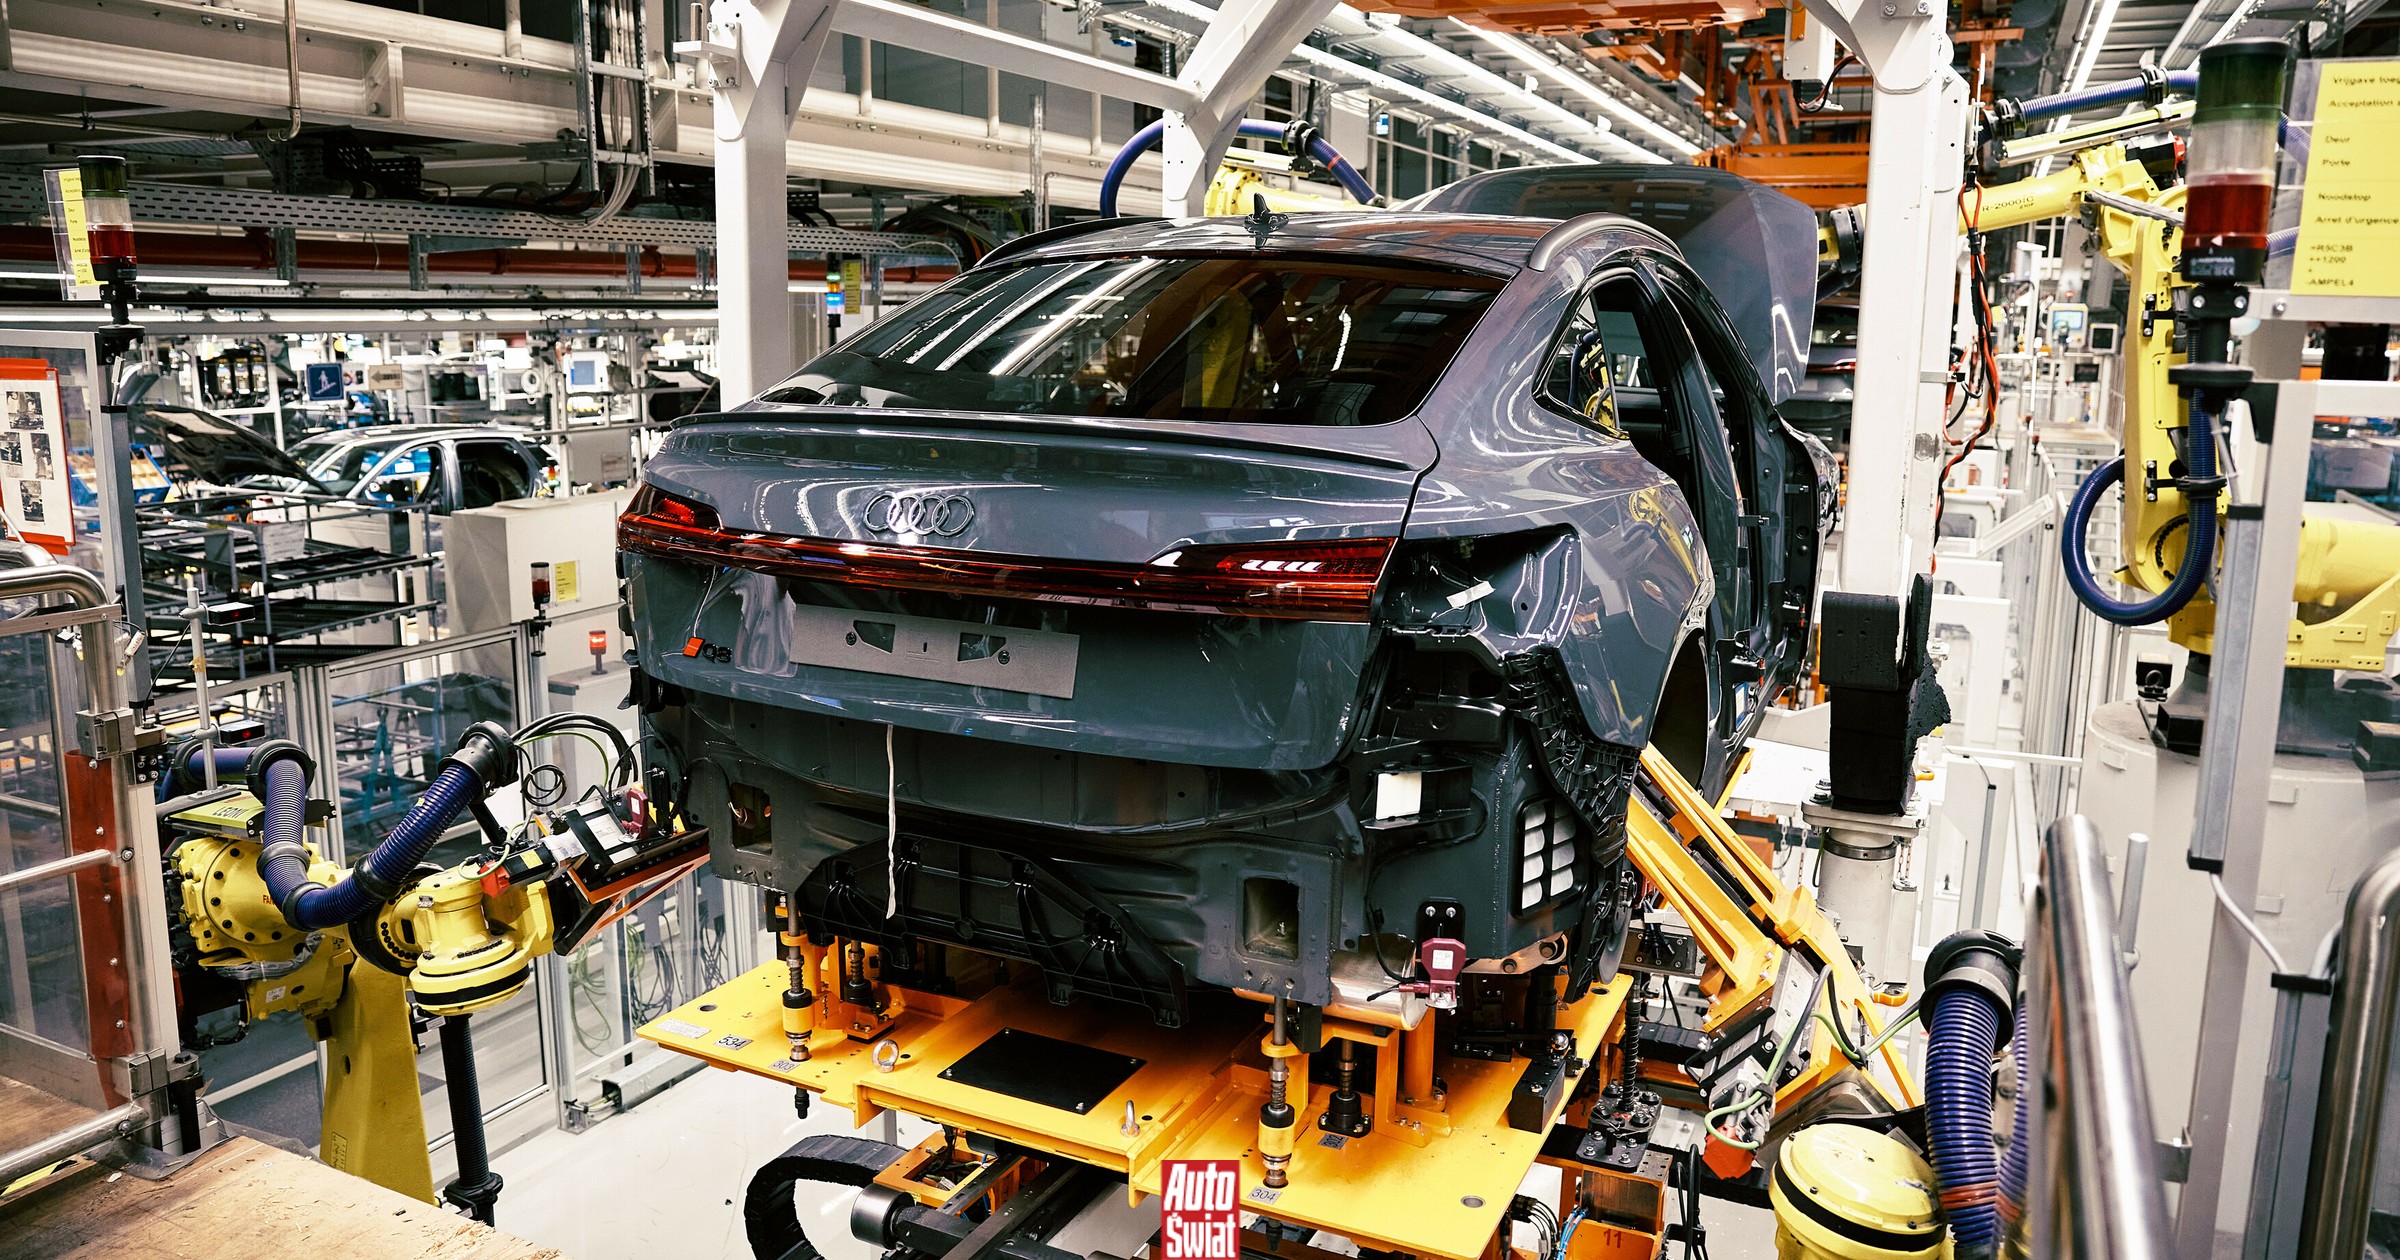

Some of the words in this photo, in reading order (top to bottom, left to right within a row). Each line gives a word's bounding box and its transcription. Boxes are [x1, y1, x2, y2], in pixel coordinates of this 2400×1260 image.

[2333, 76, 2375, 86] Vrijgave
[2329, 99, 2393, 108] Acceptation
[2325, 135, 2350, 143] Deur
[2322, 159, 2350, 167] Porte
[2318, 192, 2371, 202] Noodstop
[702, 643, 732, 664] Q8
[718, 1034, 747, 1048] 534
[772, 1059, 795, 1071] 303
[1251, 1188, 1277, 1201] 304
[1603, 1228, 1622, 1249] 11
